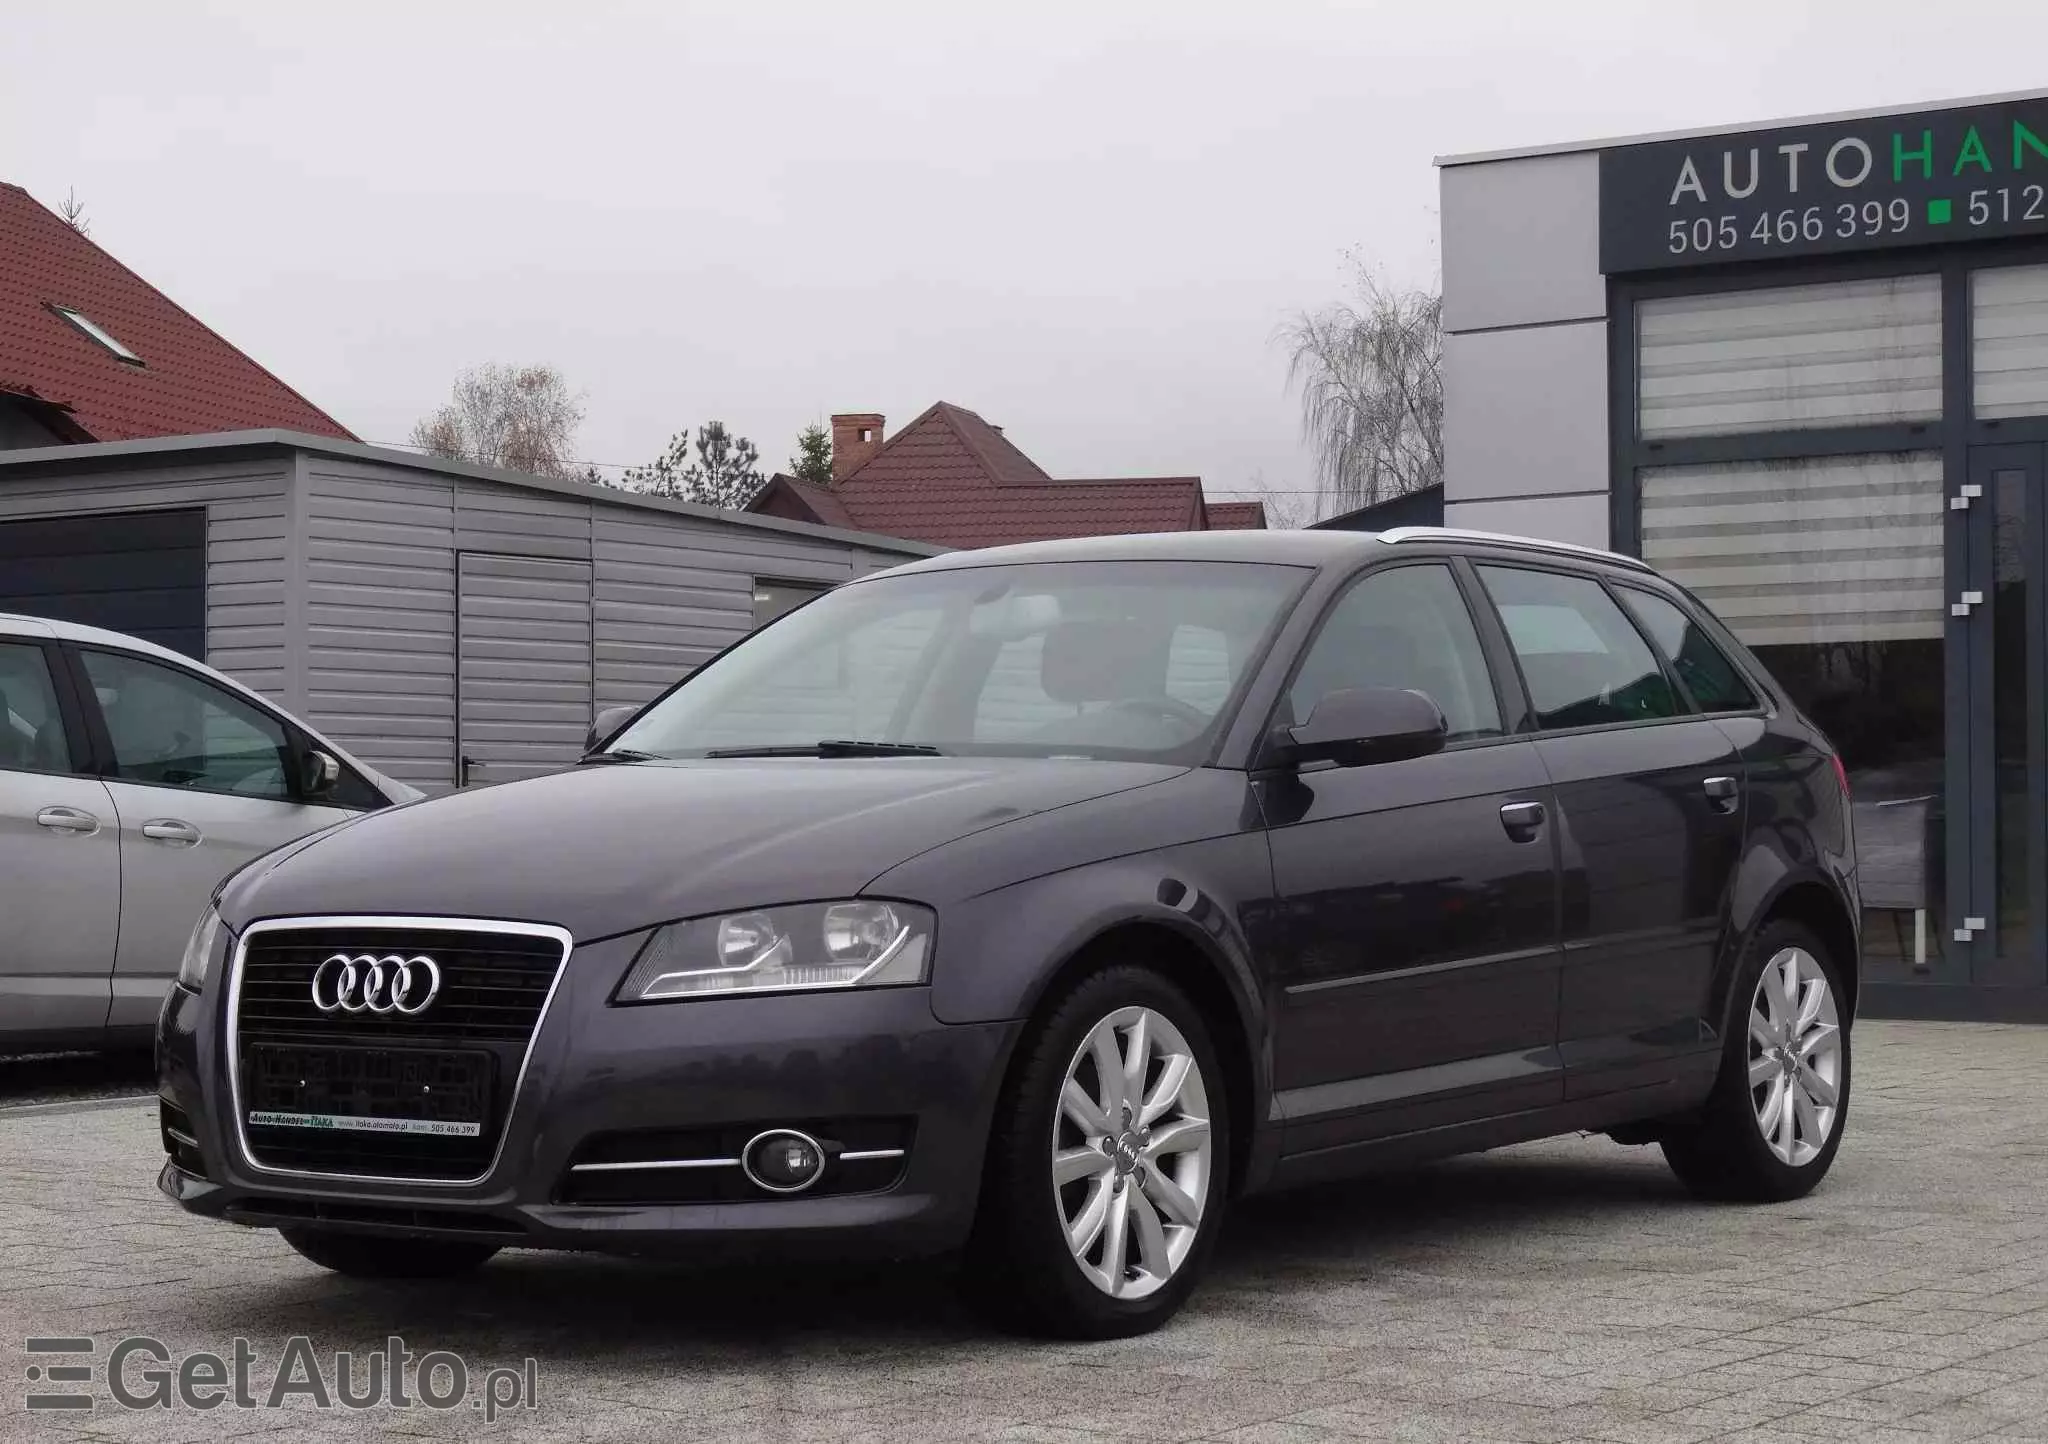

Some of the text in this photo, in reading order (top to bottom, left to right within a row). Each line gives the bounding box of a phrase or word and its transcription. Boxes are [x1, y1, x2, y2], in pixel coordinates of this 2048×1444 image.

[1668, 185, 2046, 253] 505 466 399 512
[431, 1124, 444, 1132] 505
[447, 1125, 459, 1133] 466
